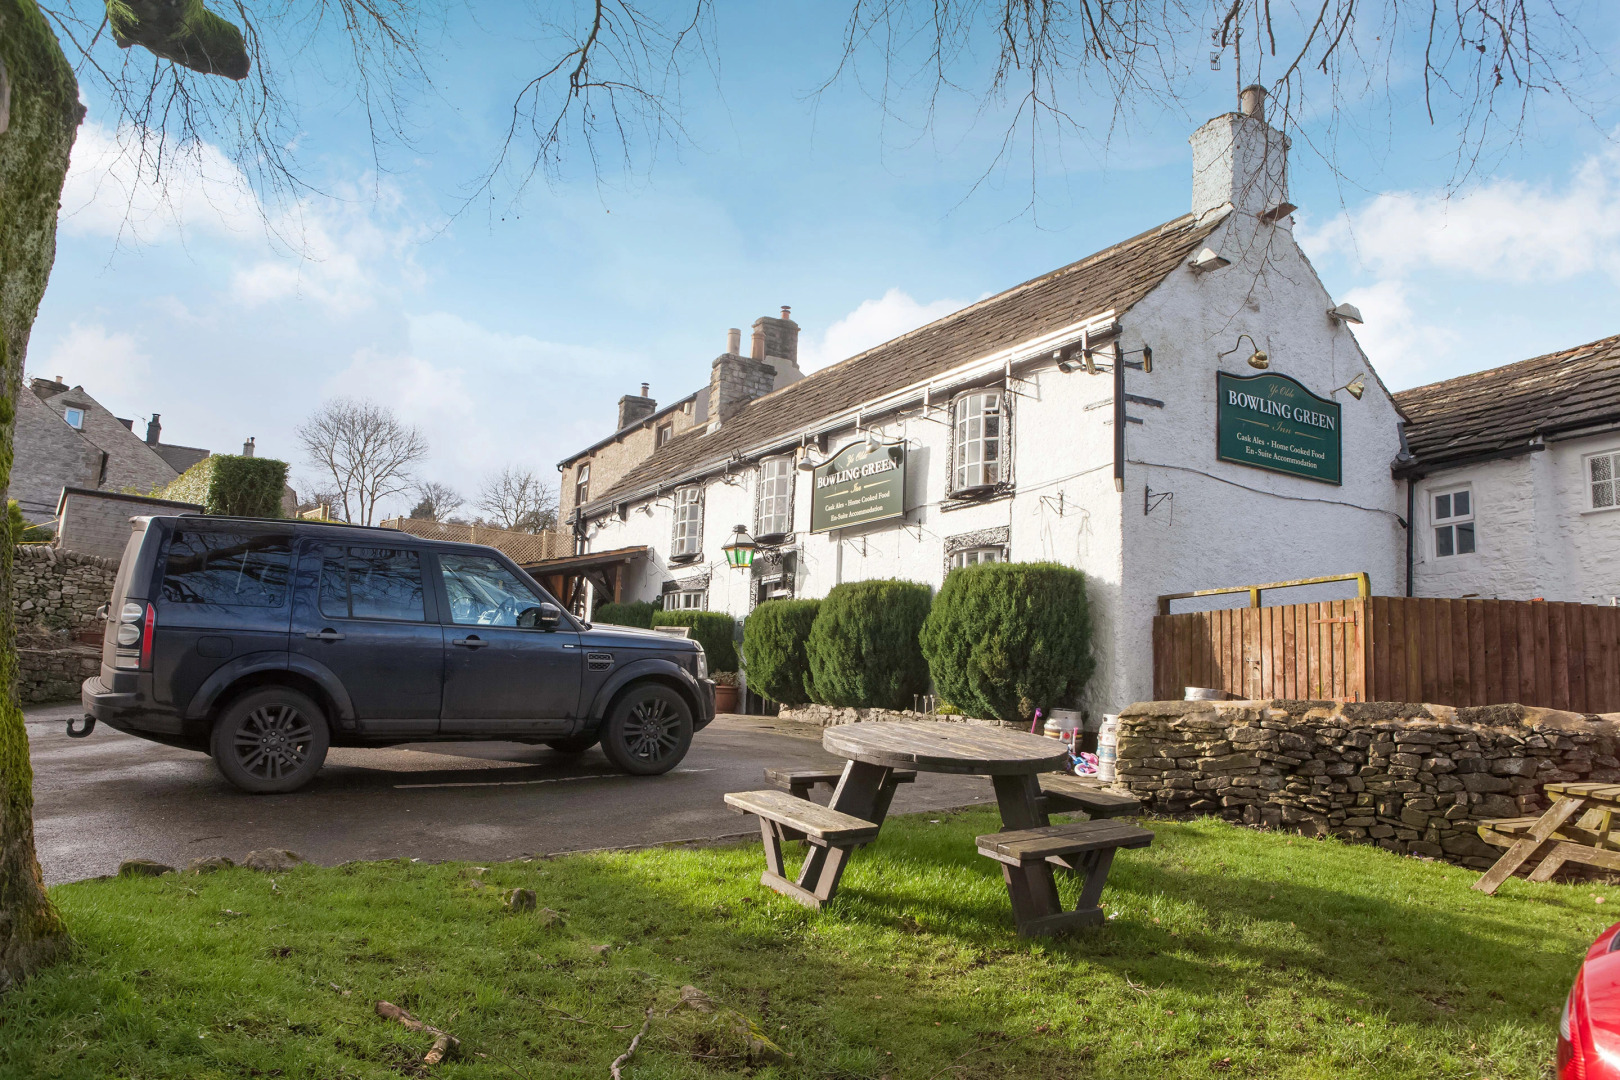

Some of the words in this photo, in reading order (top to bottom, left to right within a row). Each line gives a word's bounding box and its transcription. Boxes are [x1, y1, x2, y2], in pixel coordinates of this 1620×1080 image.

[1268, 384, 1279, 398] Ye
[1279, 386, 1295, 398] Olde
[1228, 390, 1291, 419] BOWLING
[1293, 407, 1335, 430] GREEN
[1272, 421, 1291, 434] Inn
[1236, 432, 1252, 443] Cask
[1252, 436, 1265, 446] Ales
[1271, 440, 1289, 451] Home
[1289, 445, 1311, 457] Cooked
[1311, 450, 1325, 460] Food
[1273, 453, 1318, 469] Accommodation
[817, 467, 862, 488] BOWLING
[862, 457, 897, 476] GREEN
[861, 493, 878, 503] Cooked
[878, 490, 891, 499] Food
[848, 505, 884, 518] Accommodation
